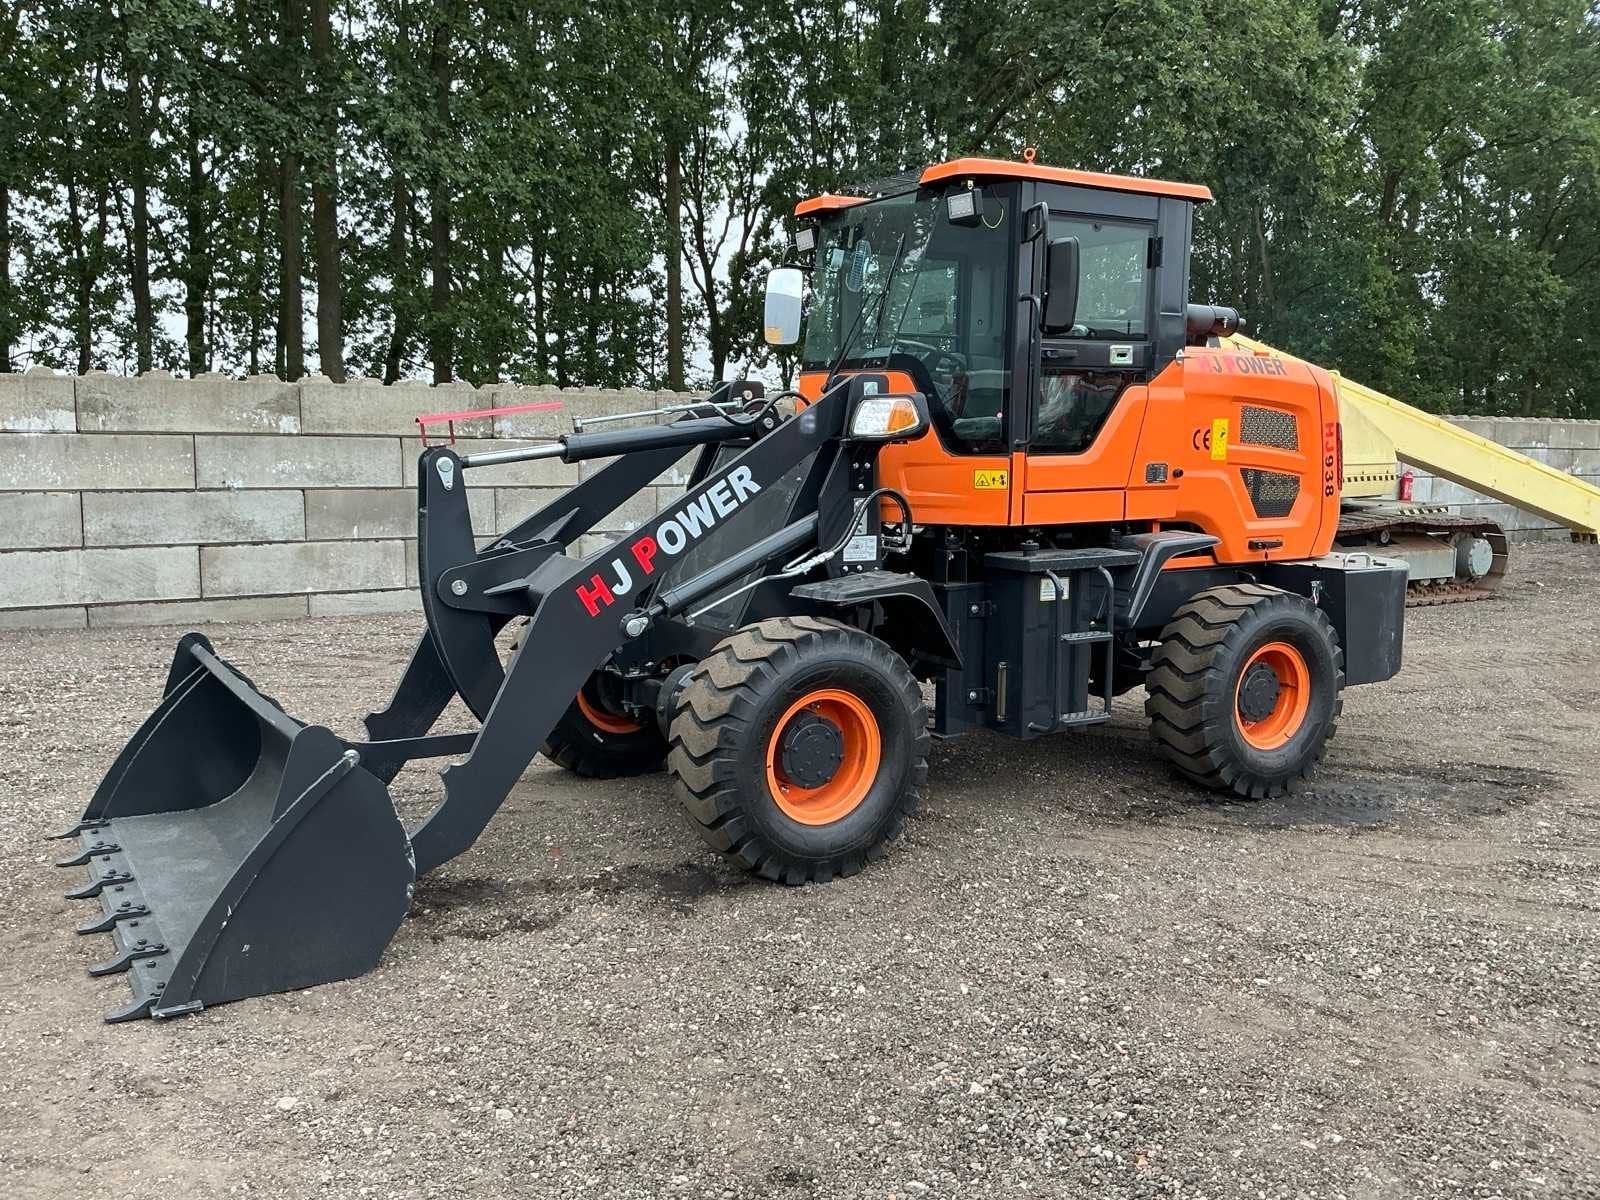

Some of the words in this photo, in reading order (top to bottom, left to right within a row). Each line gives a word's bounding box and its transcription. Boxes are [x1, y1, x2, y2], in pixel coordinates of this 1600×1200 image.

[1223, 355, 1287, 376] POWER
[1193, 429, 1211, 451] CE
[1325, 422, 1334, 497] HJ938
[576, 558, 633, 617] HJ
[631, 465, 762, 575] POWER
